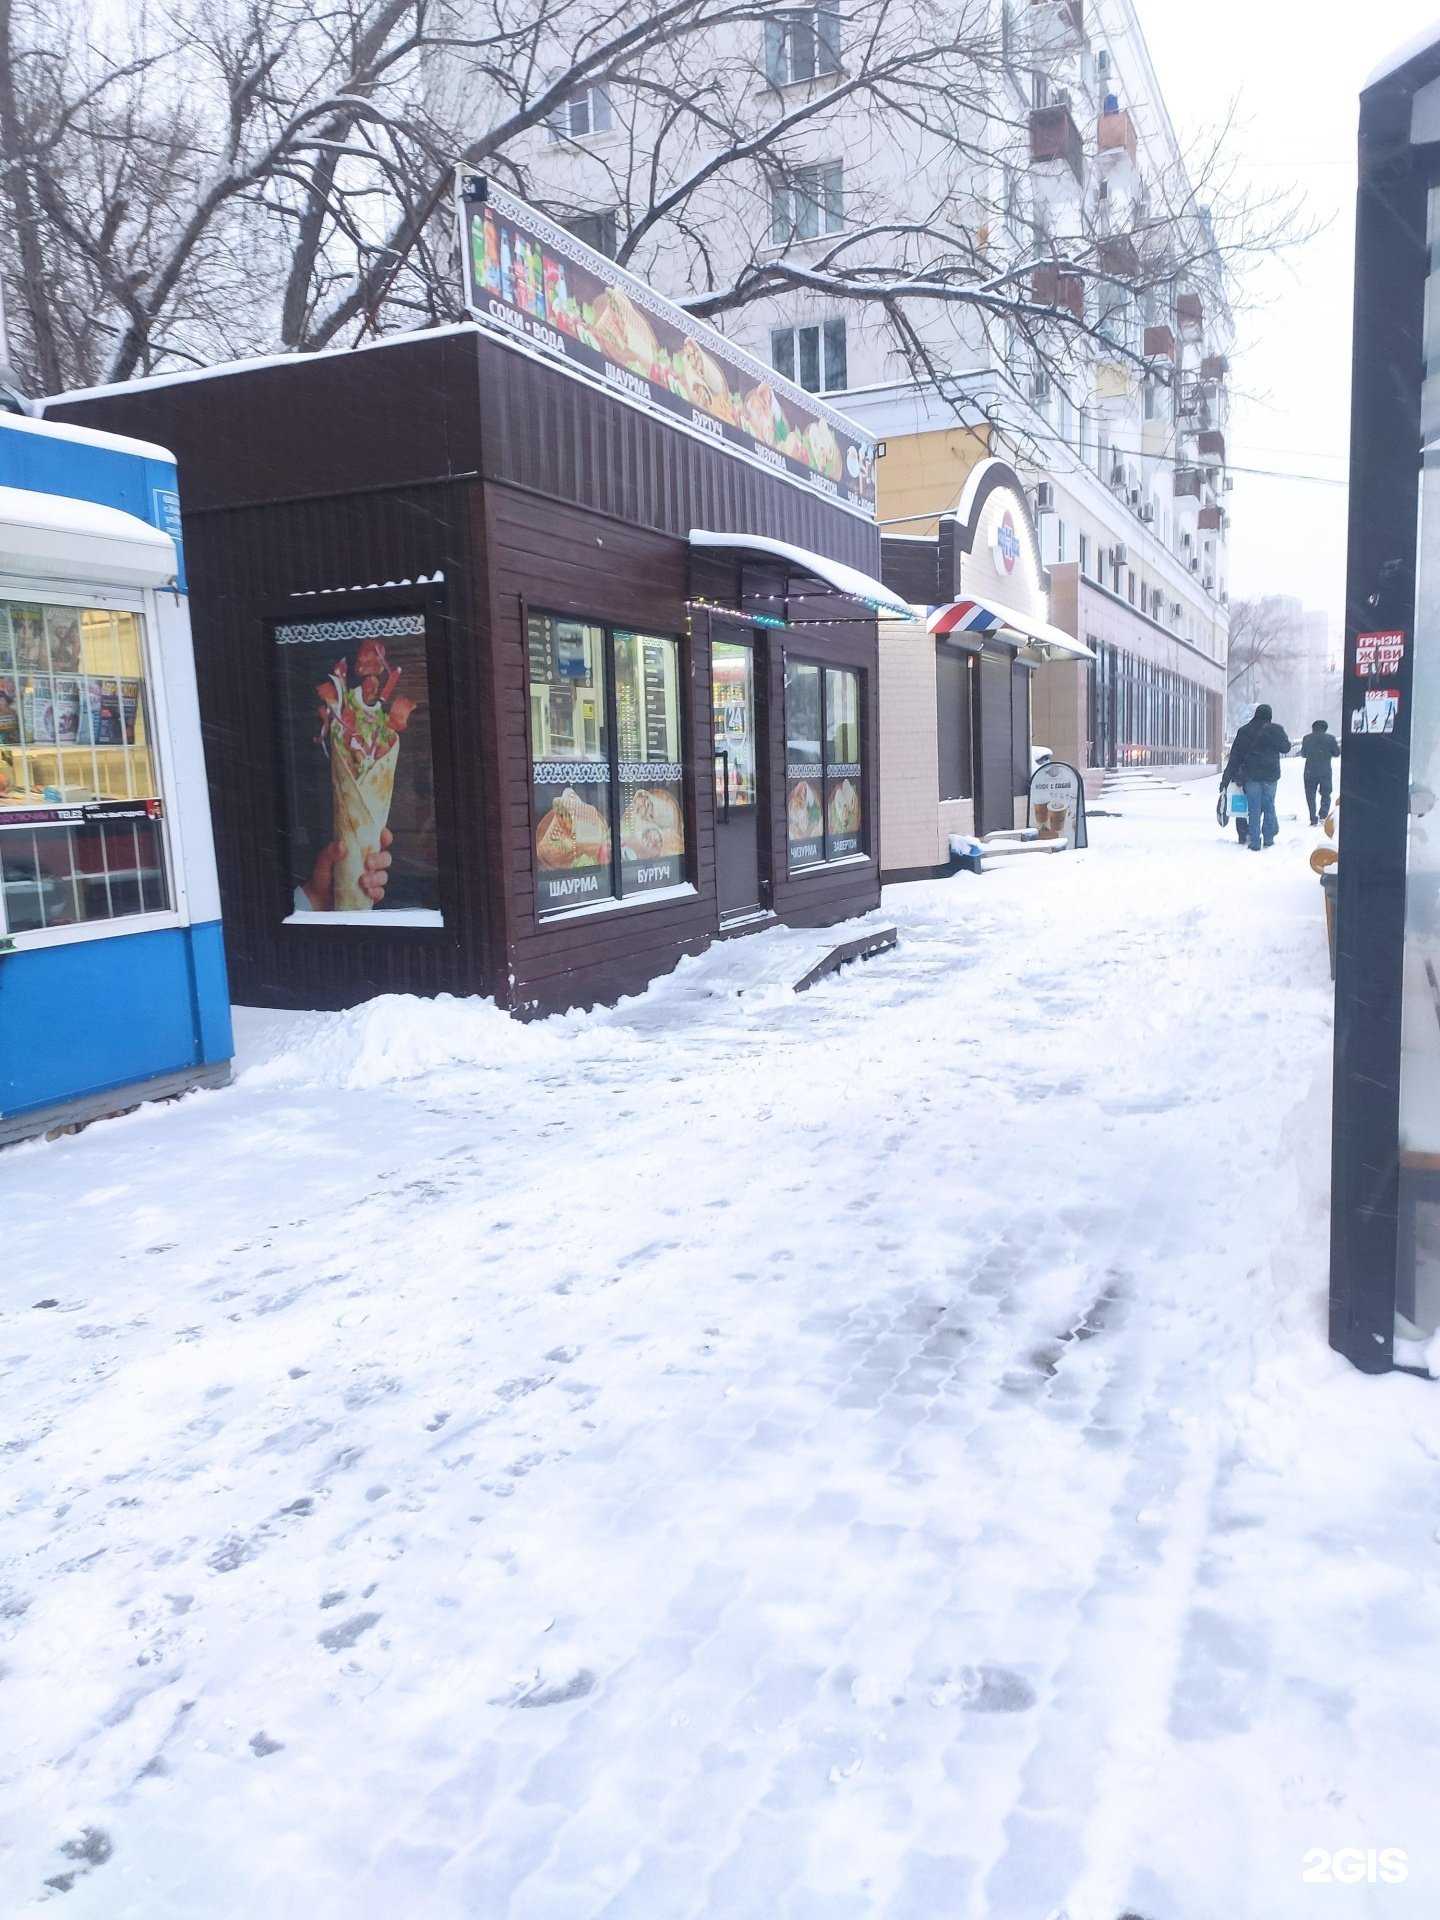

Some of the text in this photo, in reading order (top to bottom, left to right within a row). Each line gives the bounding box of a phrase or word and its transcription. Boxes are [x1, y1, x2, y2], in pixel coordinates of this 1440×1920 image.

[488, 299, 566, 354] СОКИ ВОДА
[605, 361, 651, 400] ШАУРМА
[729, 707, 743, 726] 24
[549, 875, 598, 897] ШАУРМА
